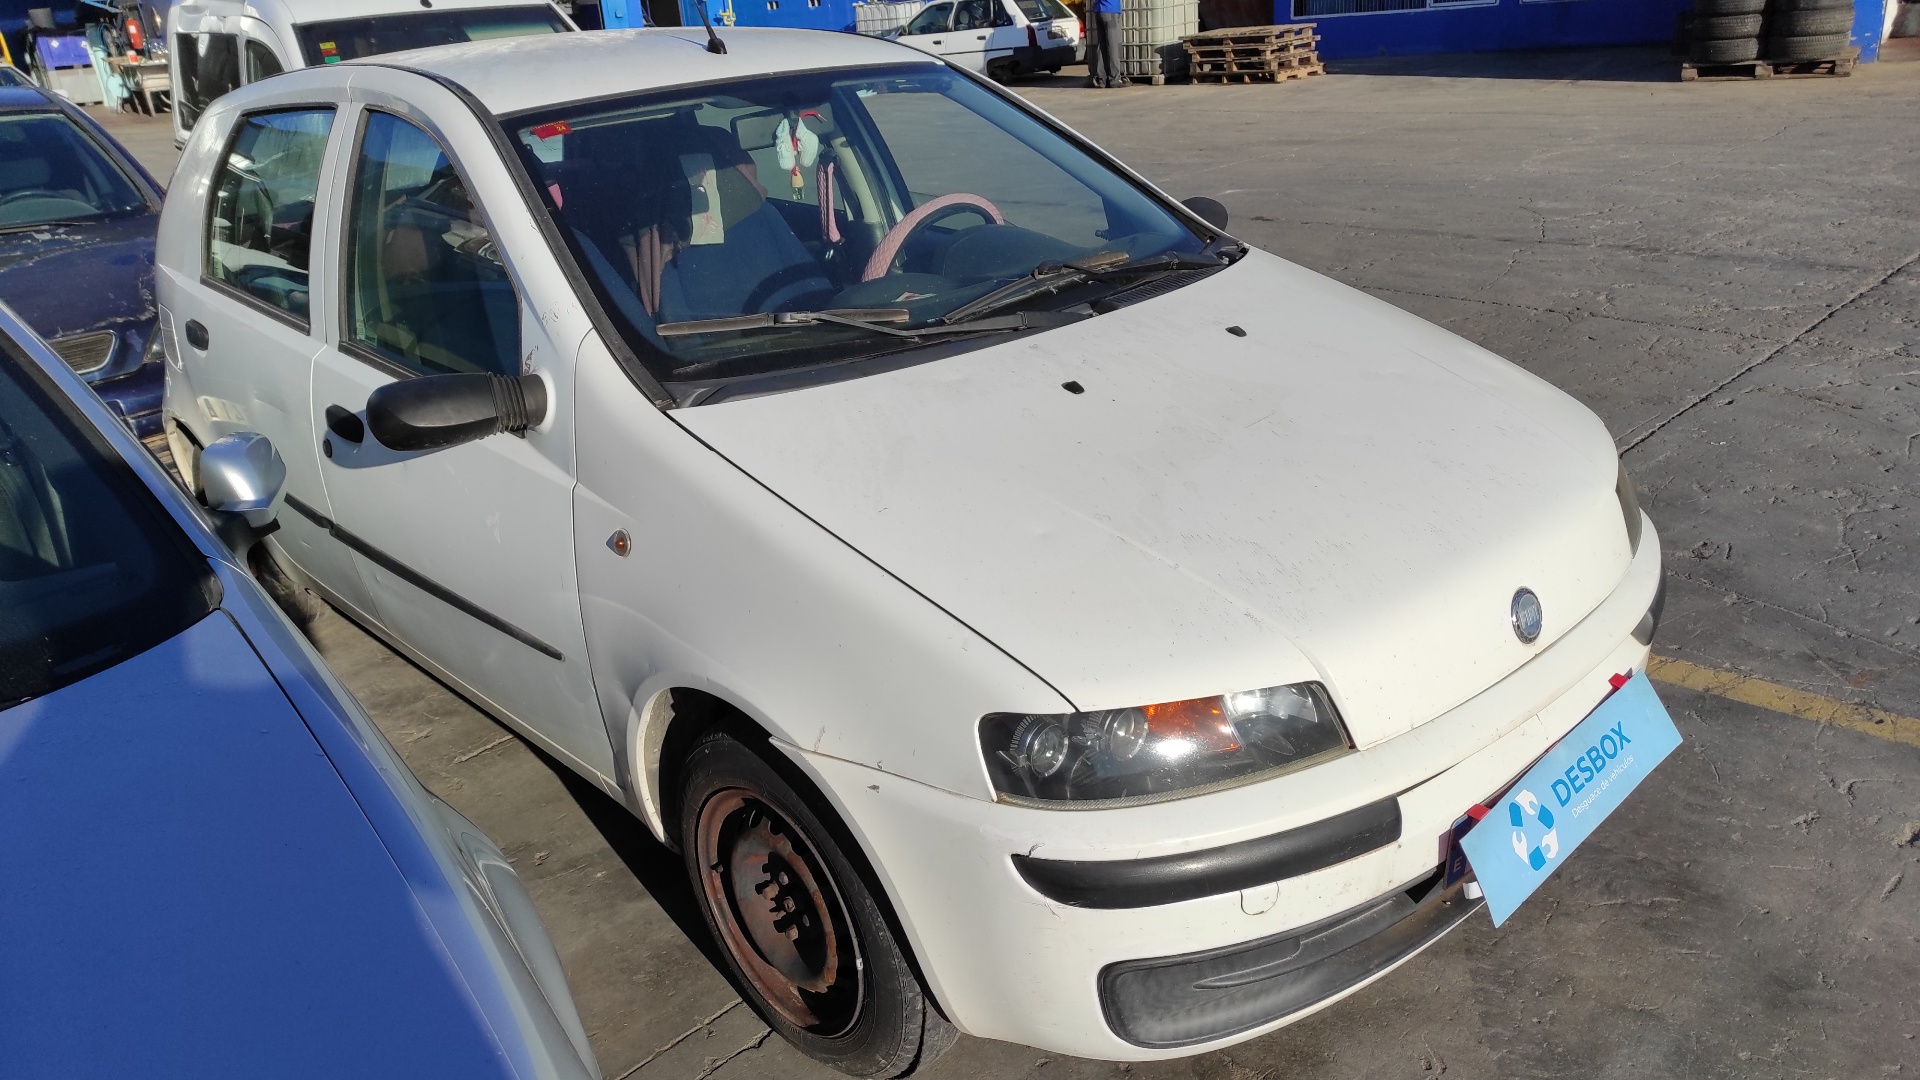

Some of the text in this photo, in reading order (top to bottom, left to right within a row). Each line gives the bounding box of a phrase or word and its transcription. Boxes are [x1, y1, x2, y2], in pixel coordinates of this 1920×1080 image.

[1551, 721, 1631, 808] DESBOX
[1571, 788, 1601, 818] Desguace
[1601, 780, 1609, 790] de
[1453, 856, 1462, 873] E
